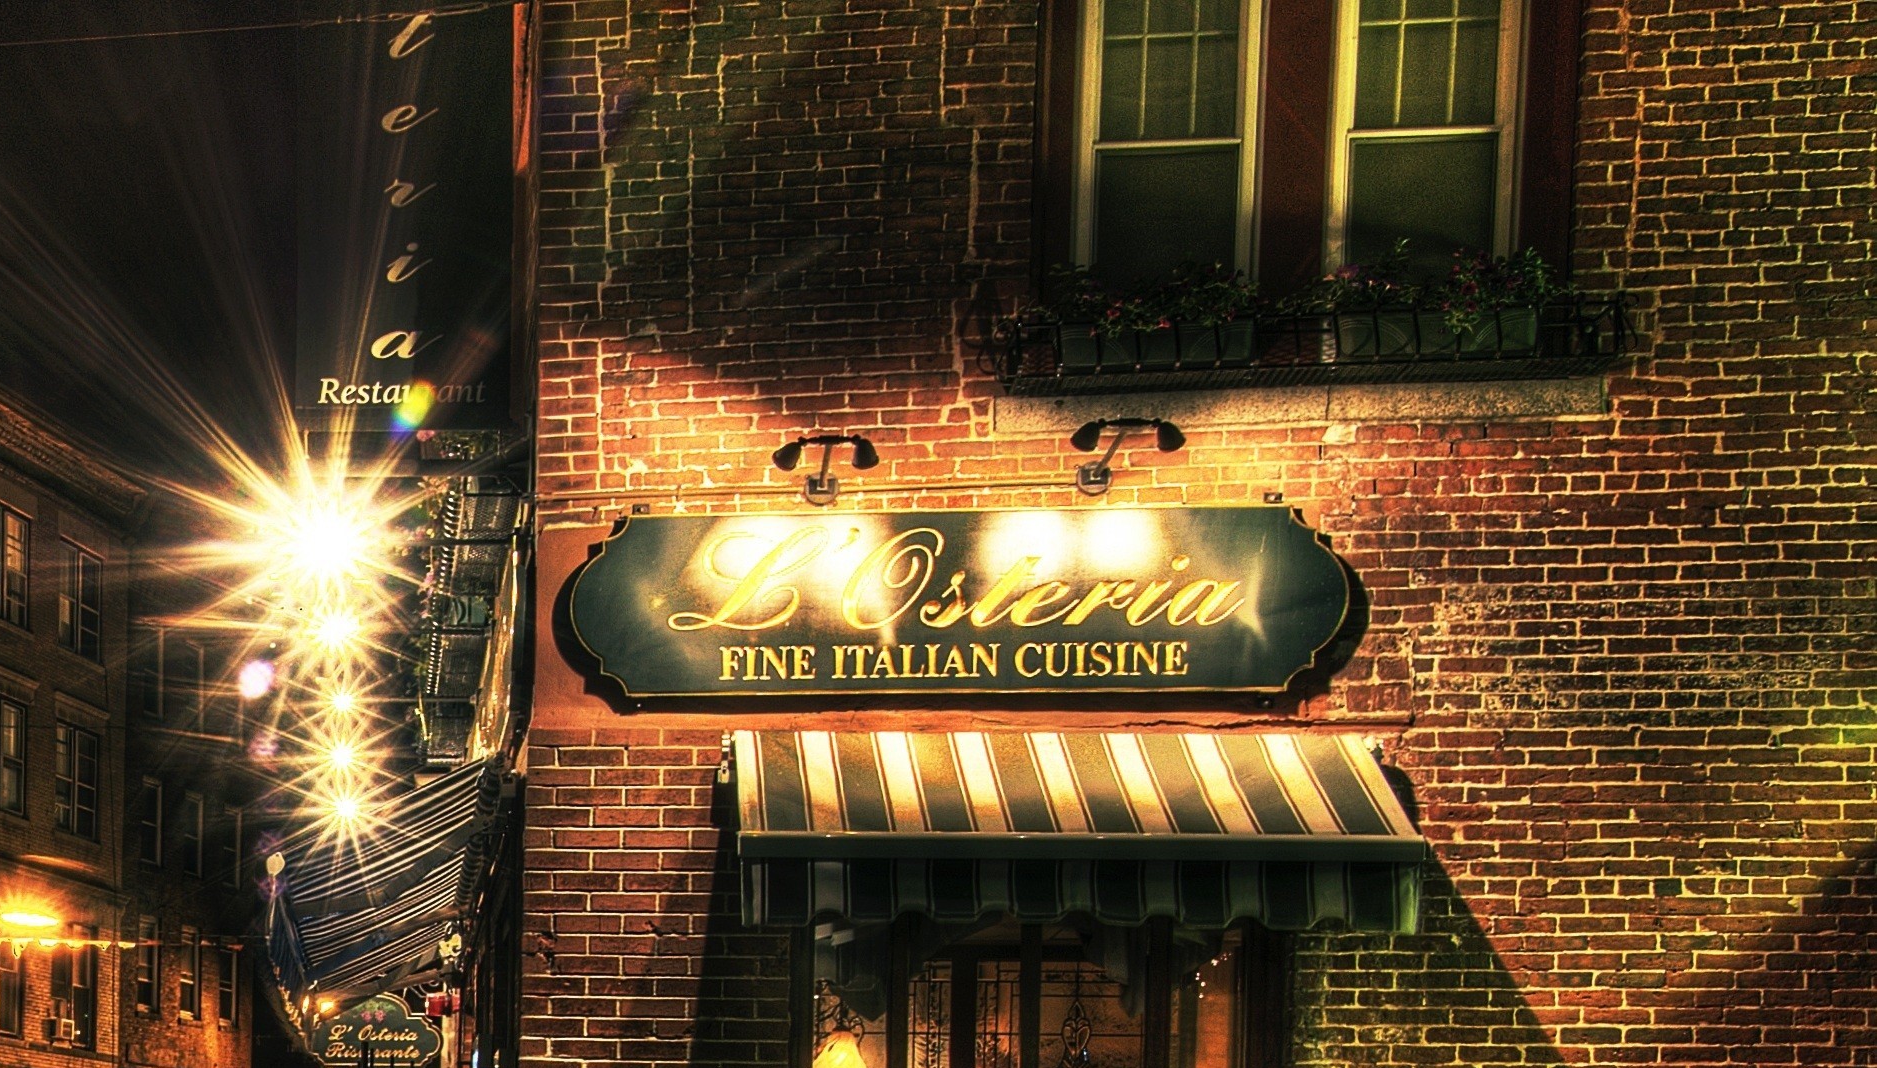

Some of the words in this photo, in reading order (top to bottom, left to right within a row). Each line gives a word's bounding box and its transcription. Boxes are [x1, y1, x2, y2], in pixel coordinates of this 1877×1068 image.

[317, 377, 486, 404] Restauant
[719, 645, 816, 681] FINE
[831, 642, 1001, 679] ITALIAN
[1013, 640, 1189, 677] CUISINE
[325, 1041, 421, 1058] Risrante
